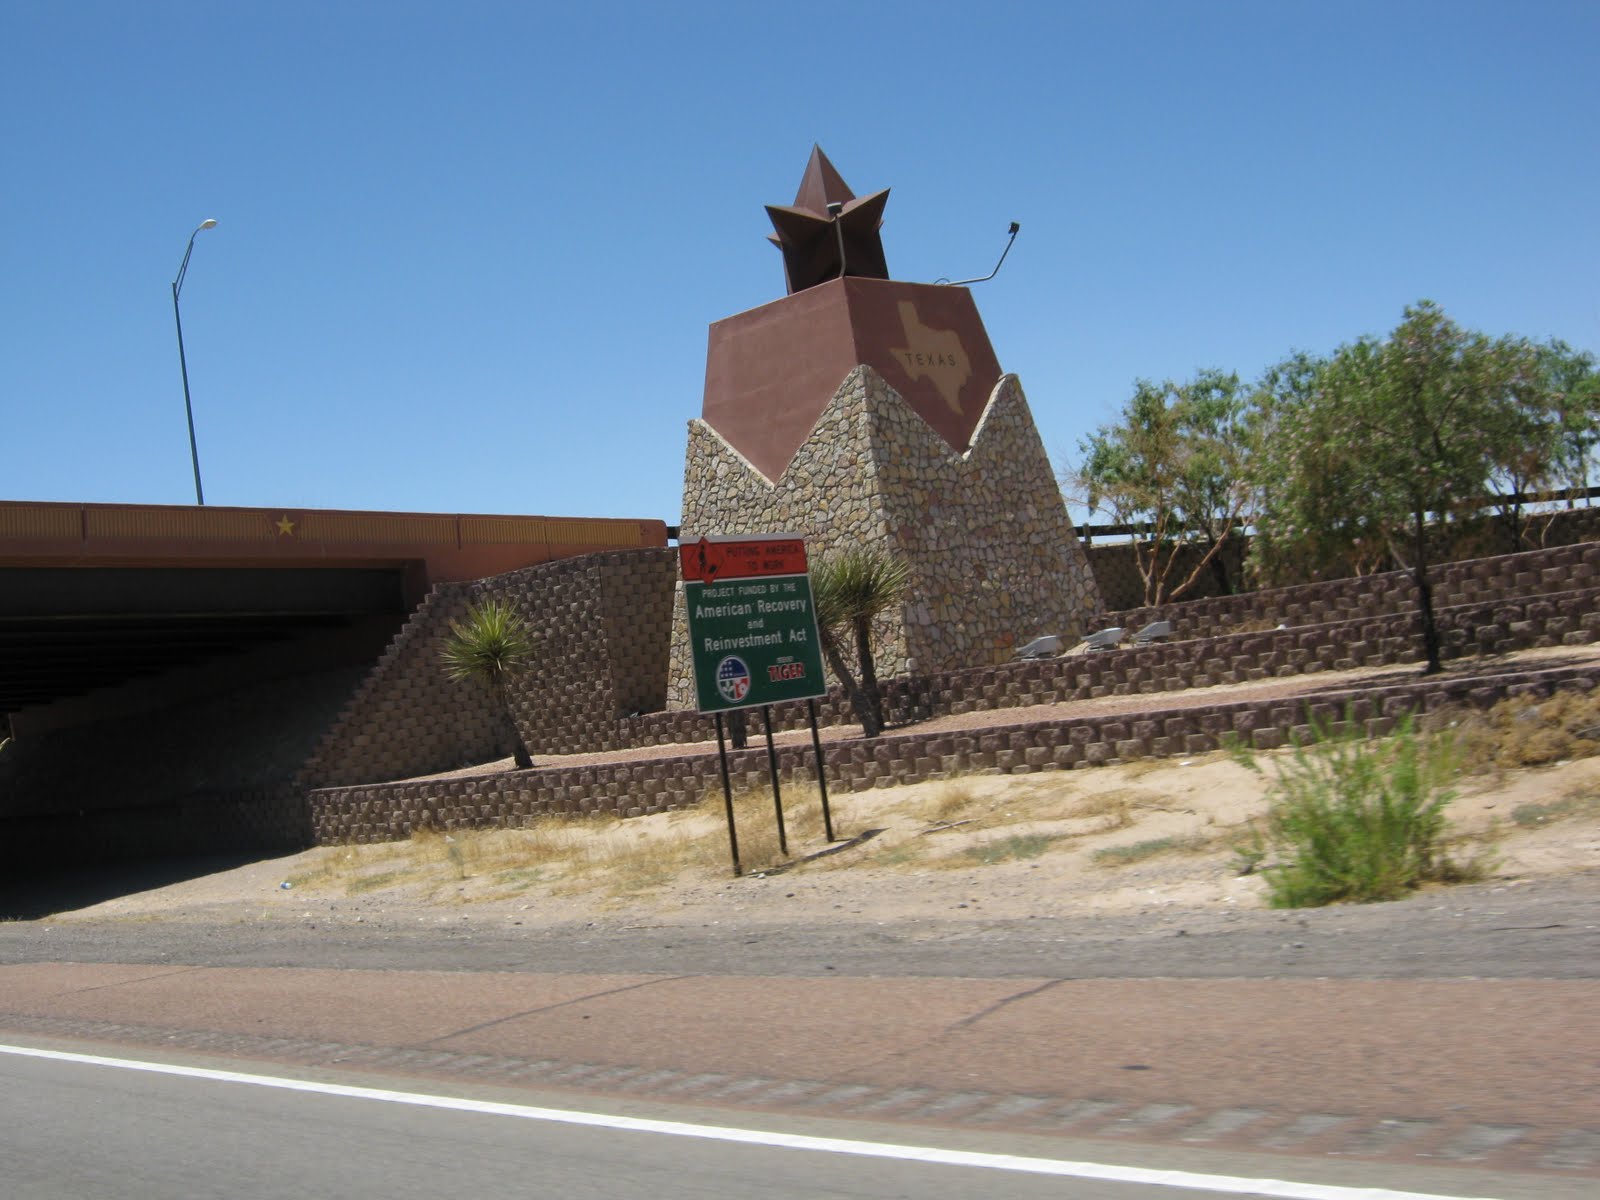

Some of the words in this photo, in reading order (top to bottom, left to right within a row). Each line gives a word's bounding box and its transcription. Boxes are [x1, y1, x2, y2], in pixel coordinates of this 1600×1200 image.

[905, 353, 956, 367] TEXAS
[765, 544, 801, 555] AMERICA
[746, 560, 757, 570] TO
[702, 587, 735, 598] PROJECT
[738, 585, 767, 595] FUNDED
[769, 584, 780, 593] BY
[783, 583, 797, 592] THE
[695, 603, 753, 619] American
[757, 599, 807, 613] Recovery
[747, 618, 765, 629] and
[704, 632, 783, 652] Reinvestment
[789, 628, 807, 643] Act
[767, 661, 806, 682] TIGER
